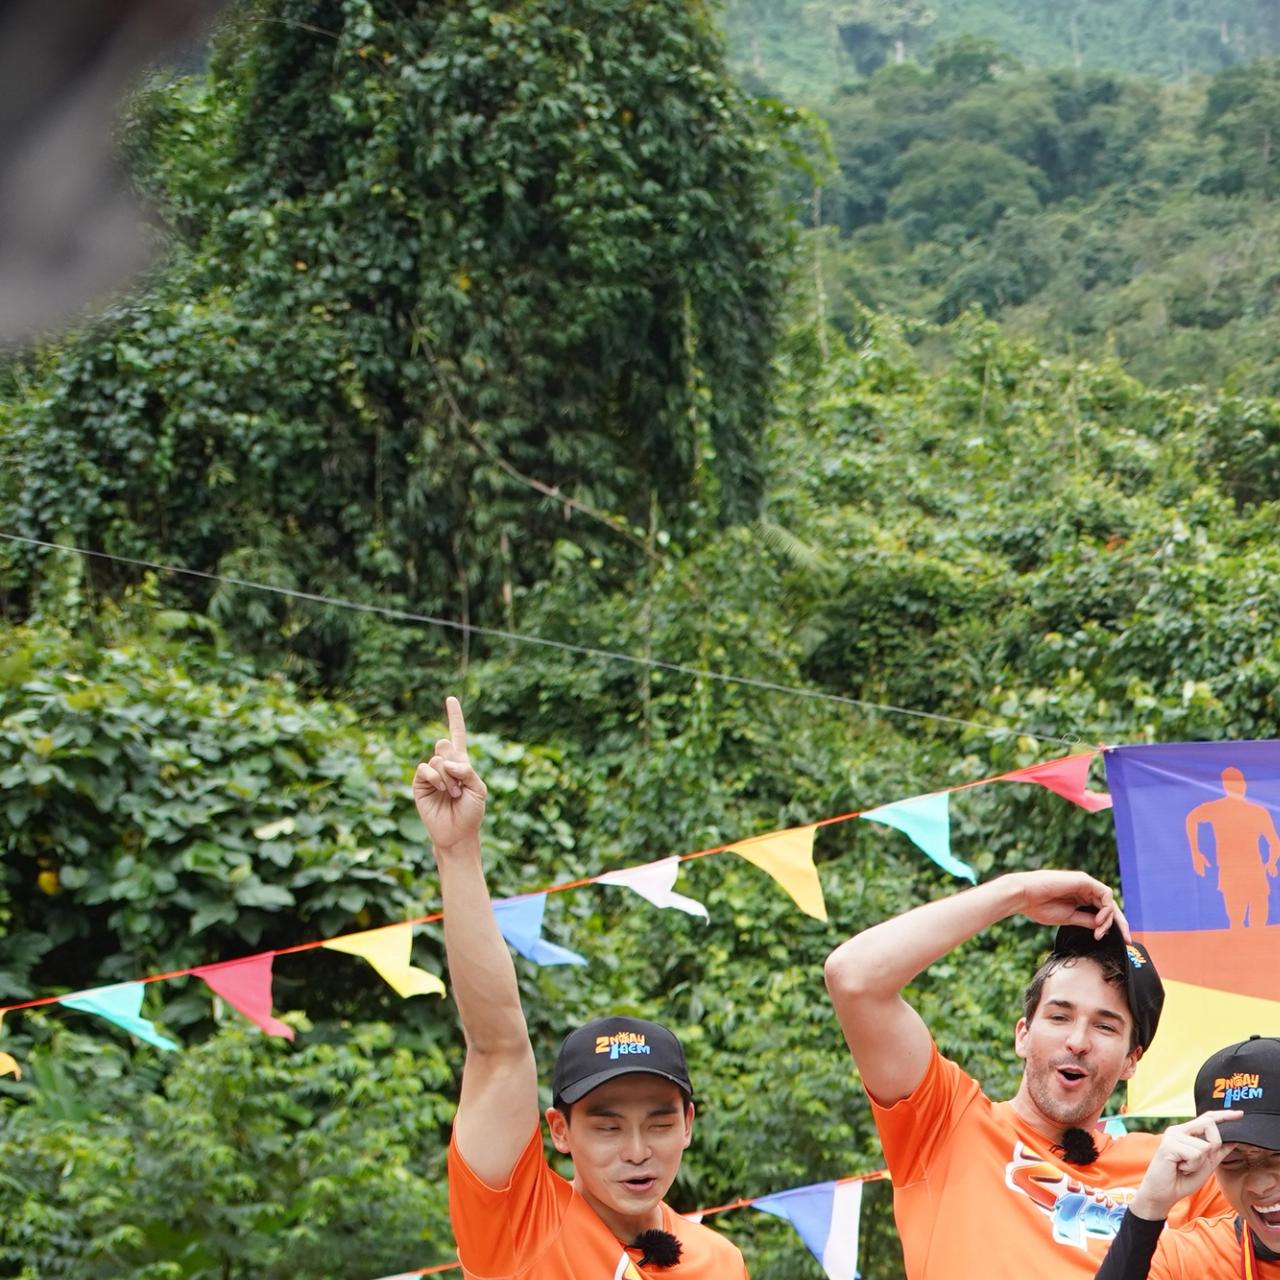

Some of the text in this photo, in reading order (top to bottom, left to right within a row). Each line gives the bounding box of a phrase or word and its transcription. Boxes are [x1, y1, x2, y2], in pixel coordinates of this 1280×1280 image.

[595, 1035, 610, 1053] 2
[610, 1043, 619, 1059] 1
[1213, 1078, 1226, 1098] 2
[1223, 1088, 1233, 1108] 1
